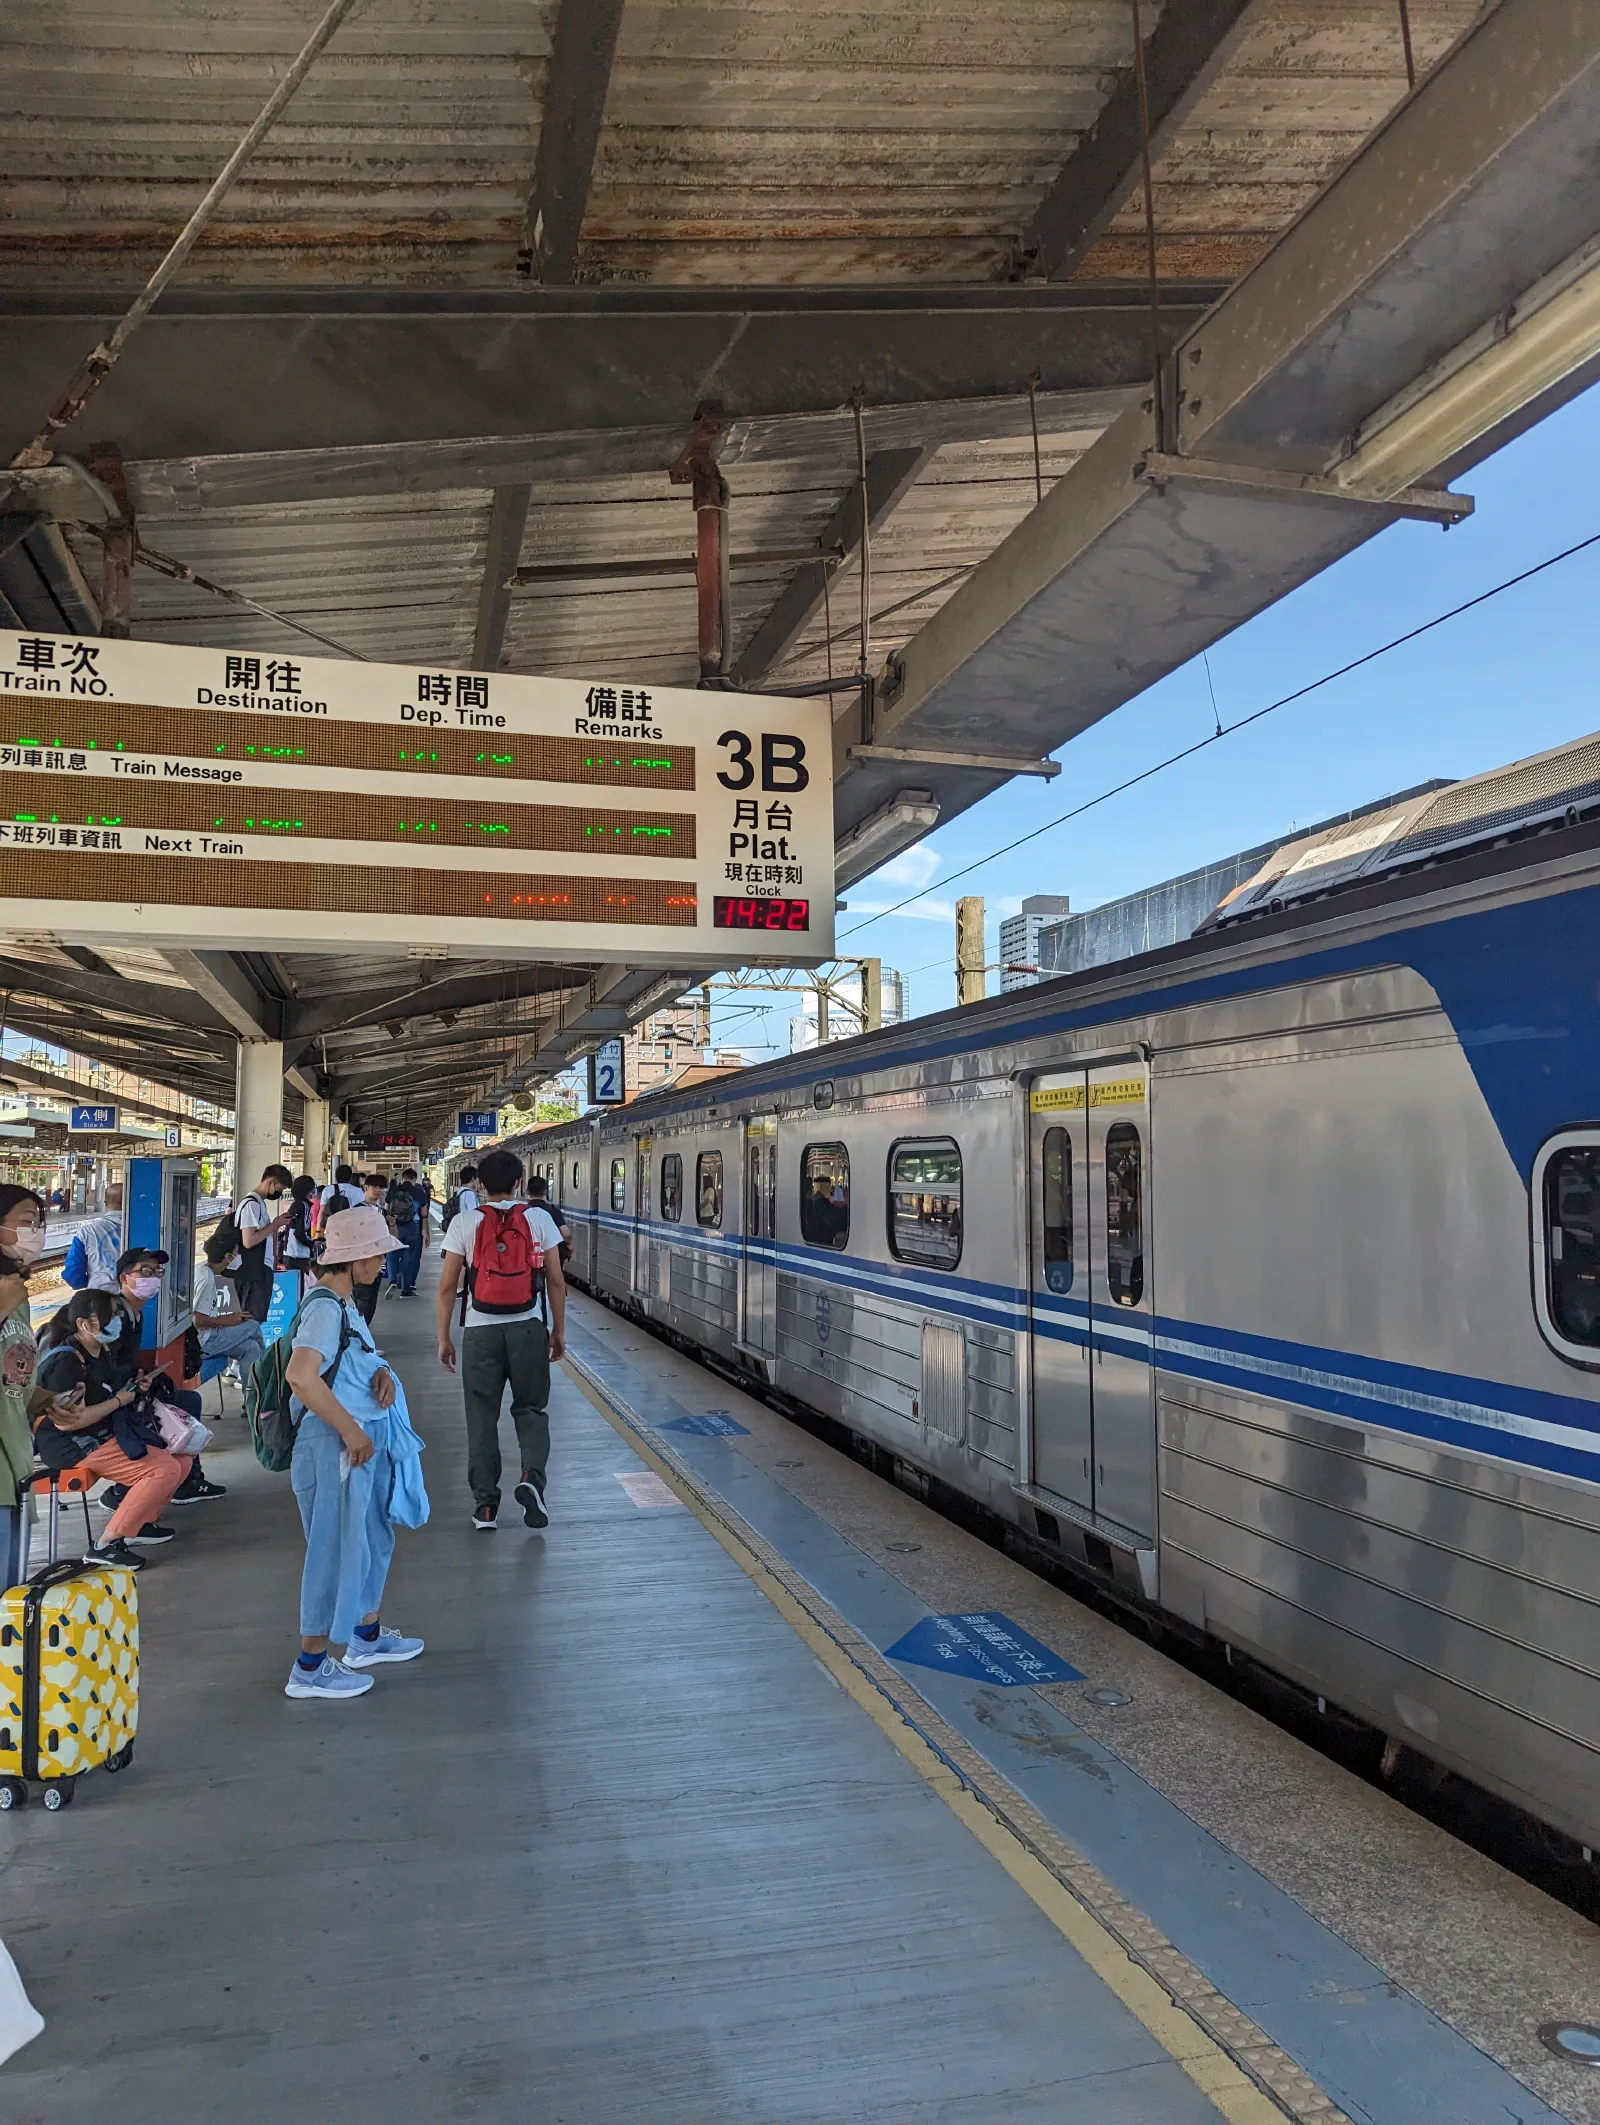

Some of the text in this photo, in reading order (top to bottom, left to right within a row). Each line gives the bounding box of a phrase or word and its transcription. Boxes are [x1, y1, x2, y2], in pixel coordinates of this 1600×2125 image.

[17, 638, 100, 676] 車次
[0, 671, 115, 697] Train NO.
[225, 655, 302, 694] 開往
[197, 688, 328, 715] Destination
[418, 674, 489, 709] 時間
[585, 687, 653, 723] 備註
[400, 704, 507, 729] Dep. Time
[575, 718, 664, 740] Remarks
[0, 747, 243, 782] 列車訊息 Train Message
[716, 730, 810, 793] 3B
[732, 799, 793, 832] 月台
[145, 836, 192, 852] Next
[200, 838, 244, 855] Train
[729, 833, 798, 861] Plat.
[725, 863, 802, 885] 現在時刻
[745, 885, 782, 897] Clock
[723, 899, 809, 930] 14:22
[600, 1065, 615, 1096] 2
[79, 1109, 108, 1122] A 側
[465, 1114, 490, 1126] B 側
[169, 1132, 176, 1145] 6
[932, 1643, 960, 1659] First
[962, 1643, 1016, 1684] Passengers
